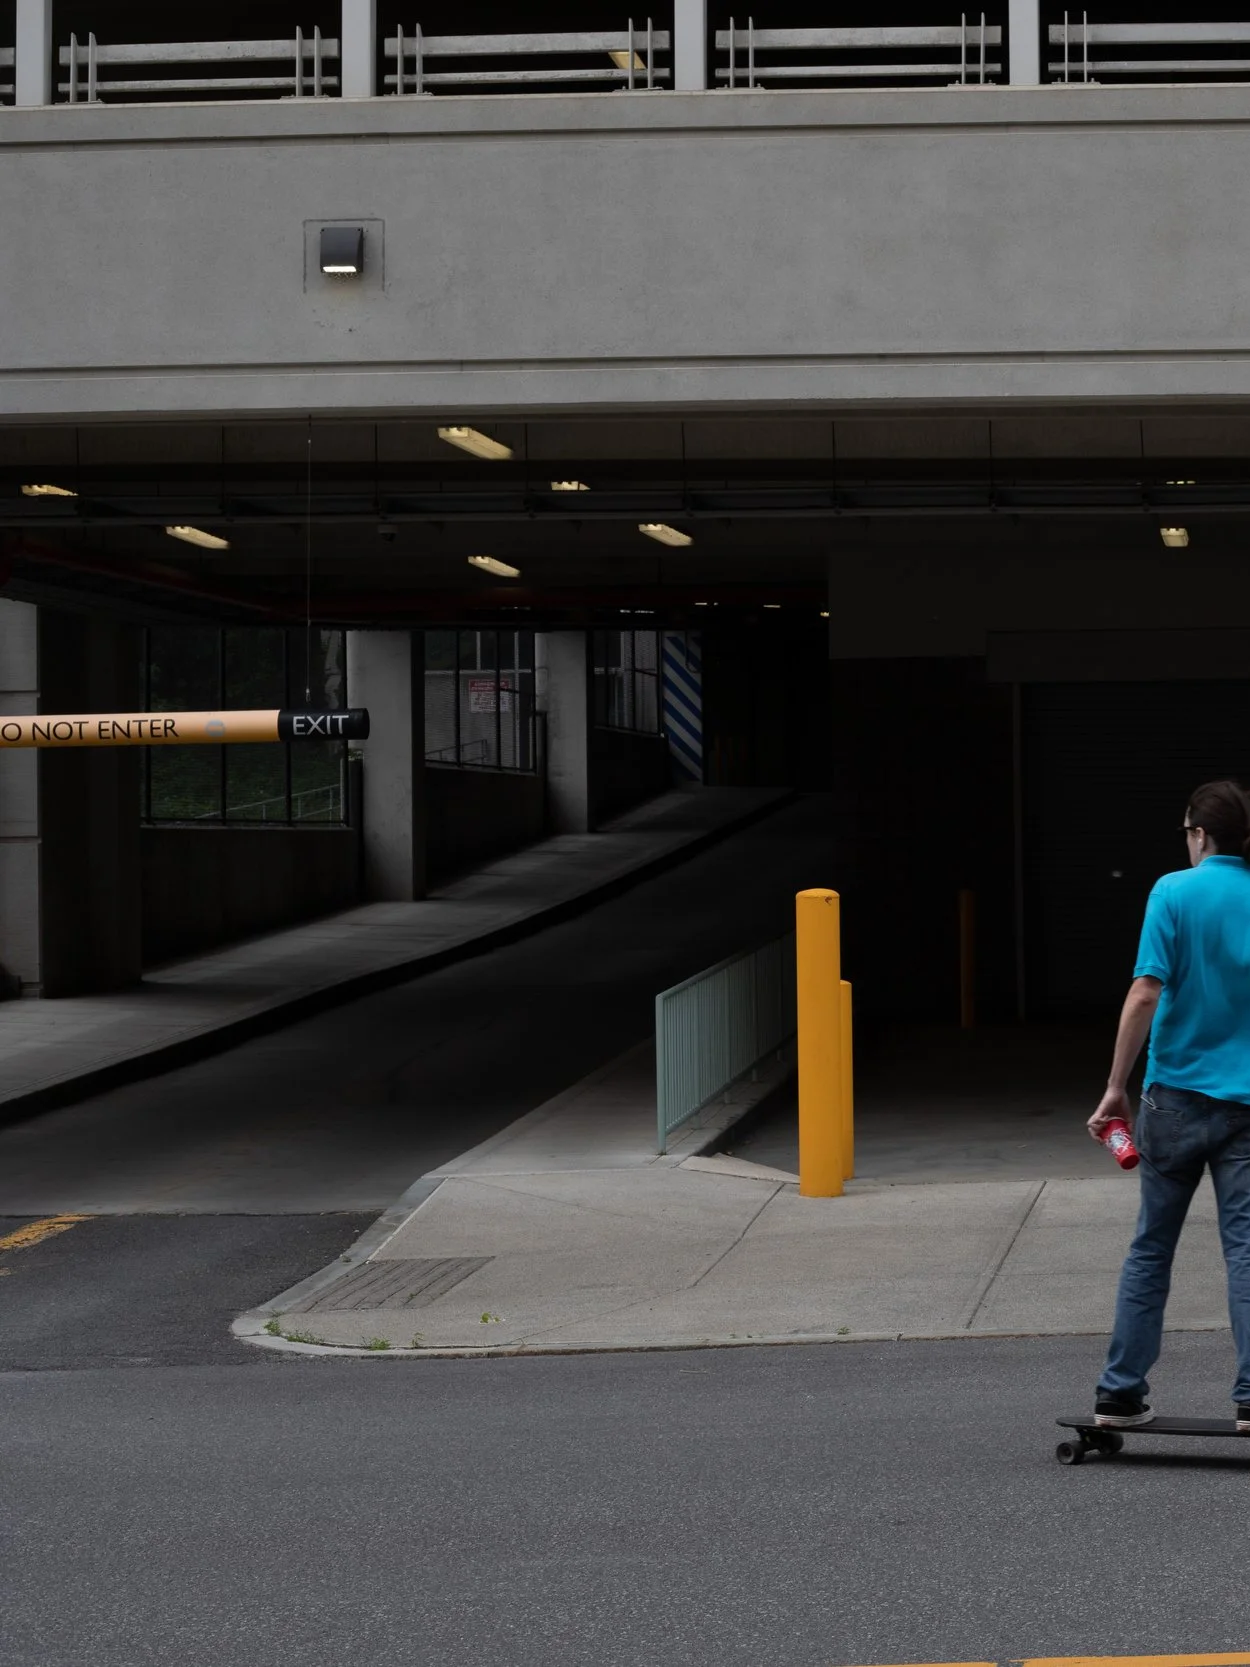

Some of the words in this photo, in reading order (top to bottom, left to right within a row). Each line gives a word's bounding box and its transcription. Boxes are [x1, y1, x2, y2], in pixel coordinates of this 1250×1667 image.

[1, 722, 22, 742] O
[32, 721, 89, 741] NOT
[98, 718, 179, 740] ENTER
[292, 714, 350, 736] EXIT
